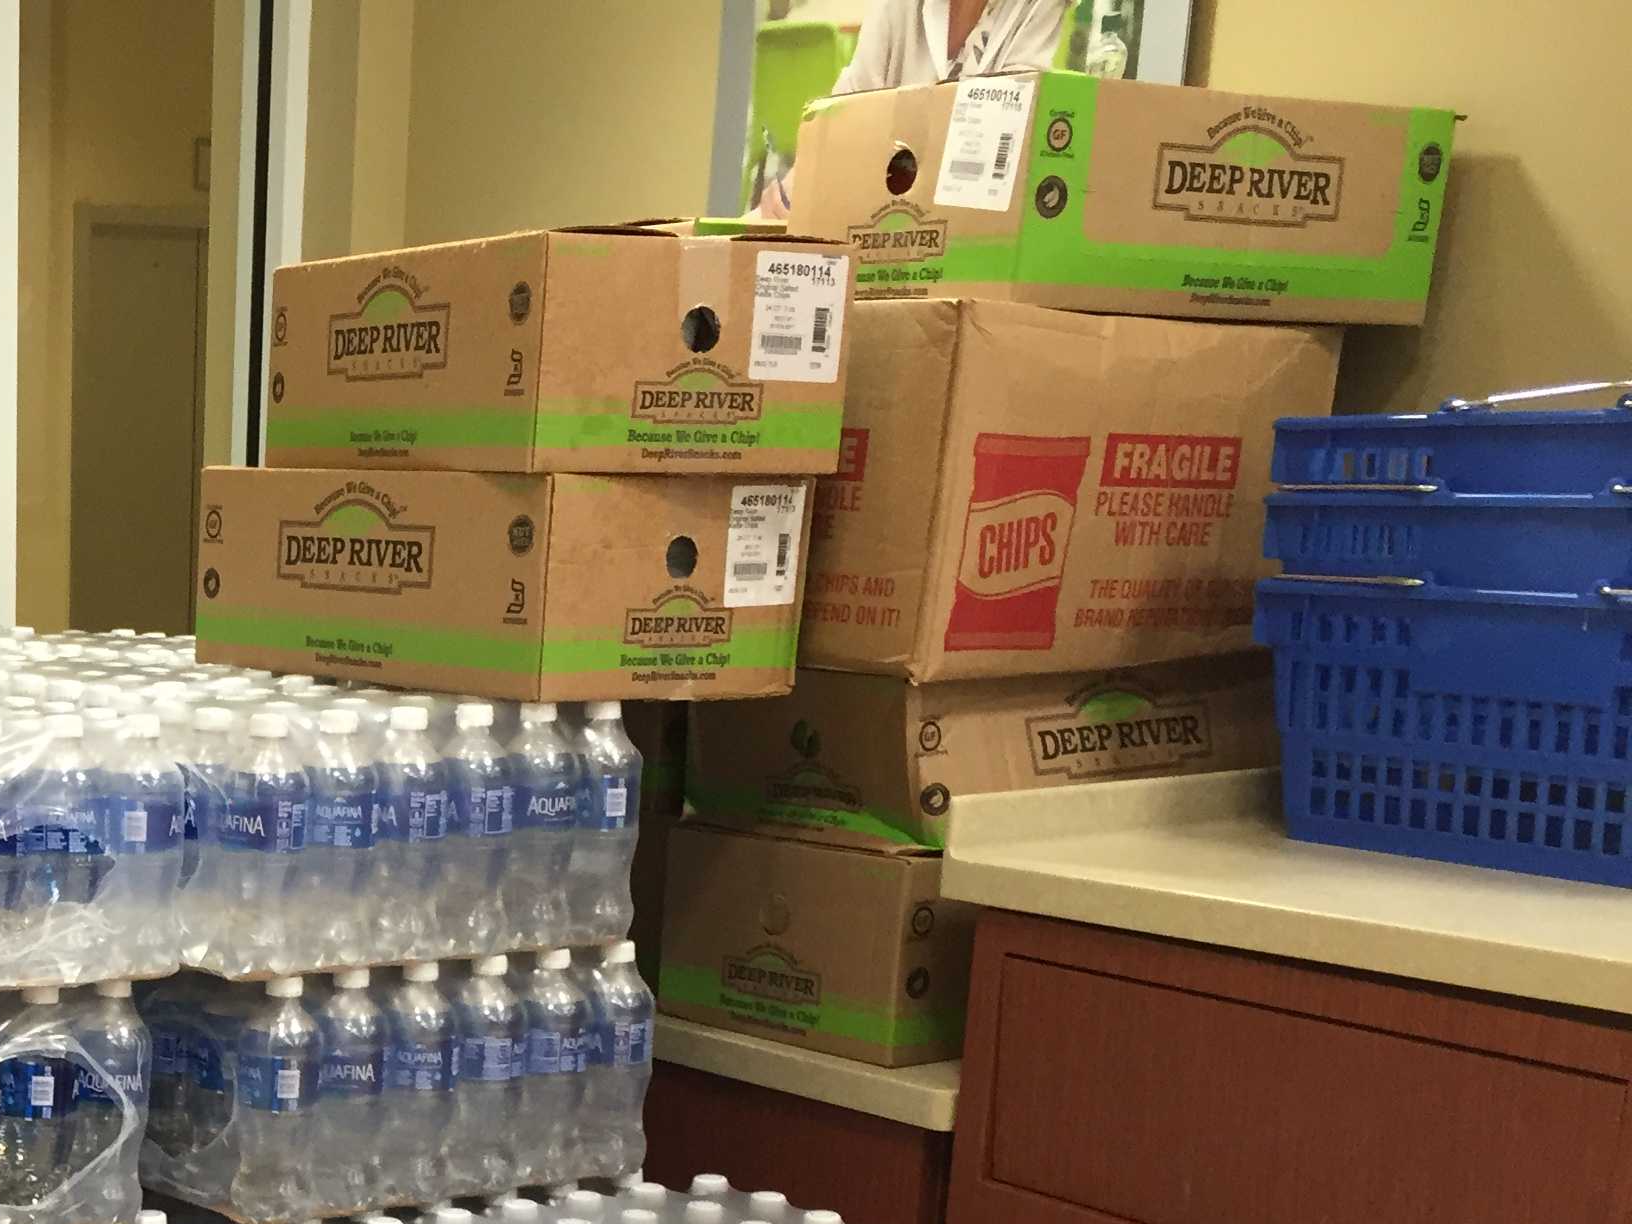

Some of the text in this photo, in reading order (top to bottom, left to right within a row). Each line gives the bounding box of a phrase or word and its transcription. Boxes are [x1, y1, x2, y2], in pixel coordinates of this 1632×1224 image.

[1053, 129, 1068, 140] GF
[1165, 160, 1331, 206] DEEP RIVER
[333, 320, 441, 361] DEEP RIVER
[639, 390, 755, 412] DEEP RIVER
[627, 429, 761, 448] Because We Give a Chip!
[1114, 443, 1236, 481] FRAGILE
[1095, 491, 1235, 518] PLEASE HANDLE
[978, 511, 1057, 579] CHIPS
[1114, 521, 1214, 547] WITH CARE
[285, 535, 423, 574] DEEP RIVER
[863, 576, 896, 598] AND
[1090, 578, 1118, 599] THE
[630, 616, 726, 635] DEEP RIVER
[855, 605, 901, 628] ON IT!
[1073, 607, 1123, 628] BRAND
[620, 653, 731, 669] Because We Give a Chip!
[1038, 715, 1202, 761] DEEP RIVER
[526, 796, 575, 816] AQUAF
[222, 814, 265, 837] AFINA
[727, 962, 816, 996] DEEP RIVER
